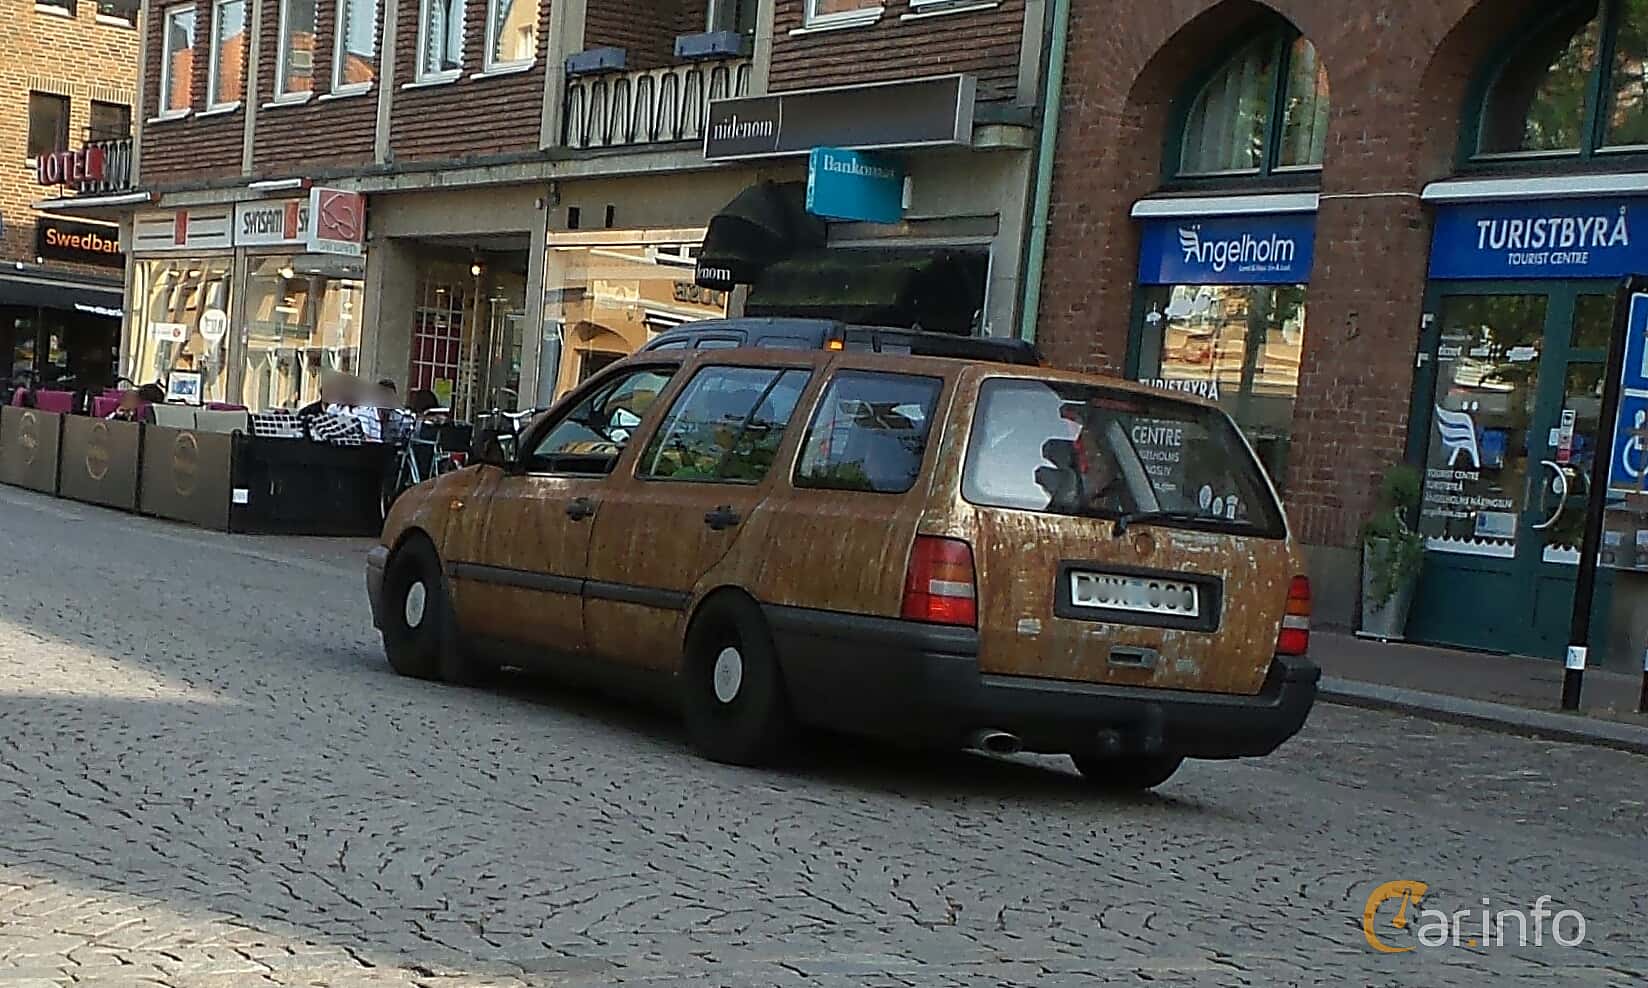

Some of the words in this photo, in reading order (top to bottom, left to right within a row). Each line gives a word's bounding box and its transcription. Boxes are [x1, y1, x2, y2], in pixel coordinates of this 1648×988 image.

[37, 148, 92, 186] HOTEL
[1477, 205, 1629, 249] TURISTBYRÅ
[1178, 224, 1294, 272] Ängelholm
[1508, 252, 1548, 265] TOURIST
[1550, 252, 1589, 265] CENTRE
[1132, 425, 1182, 446] CENTRE
